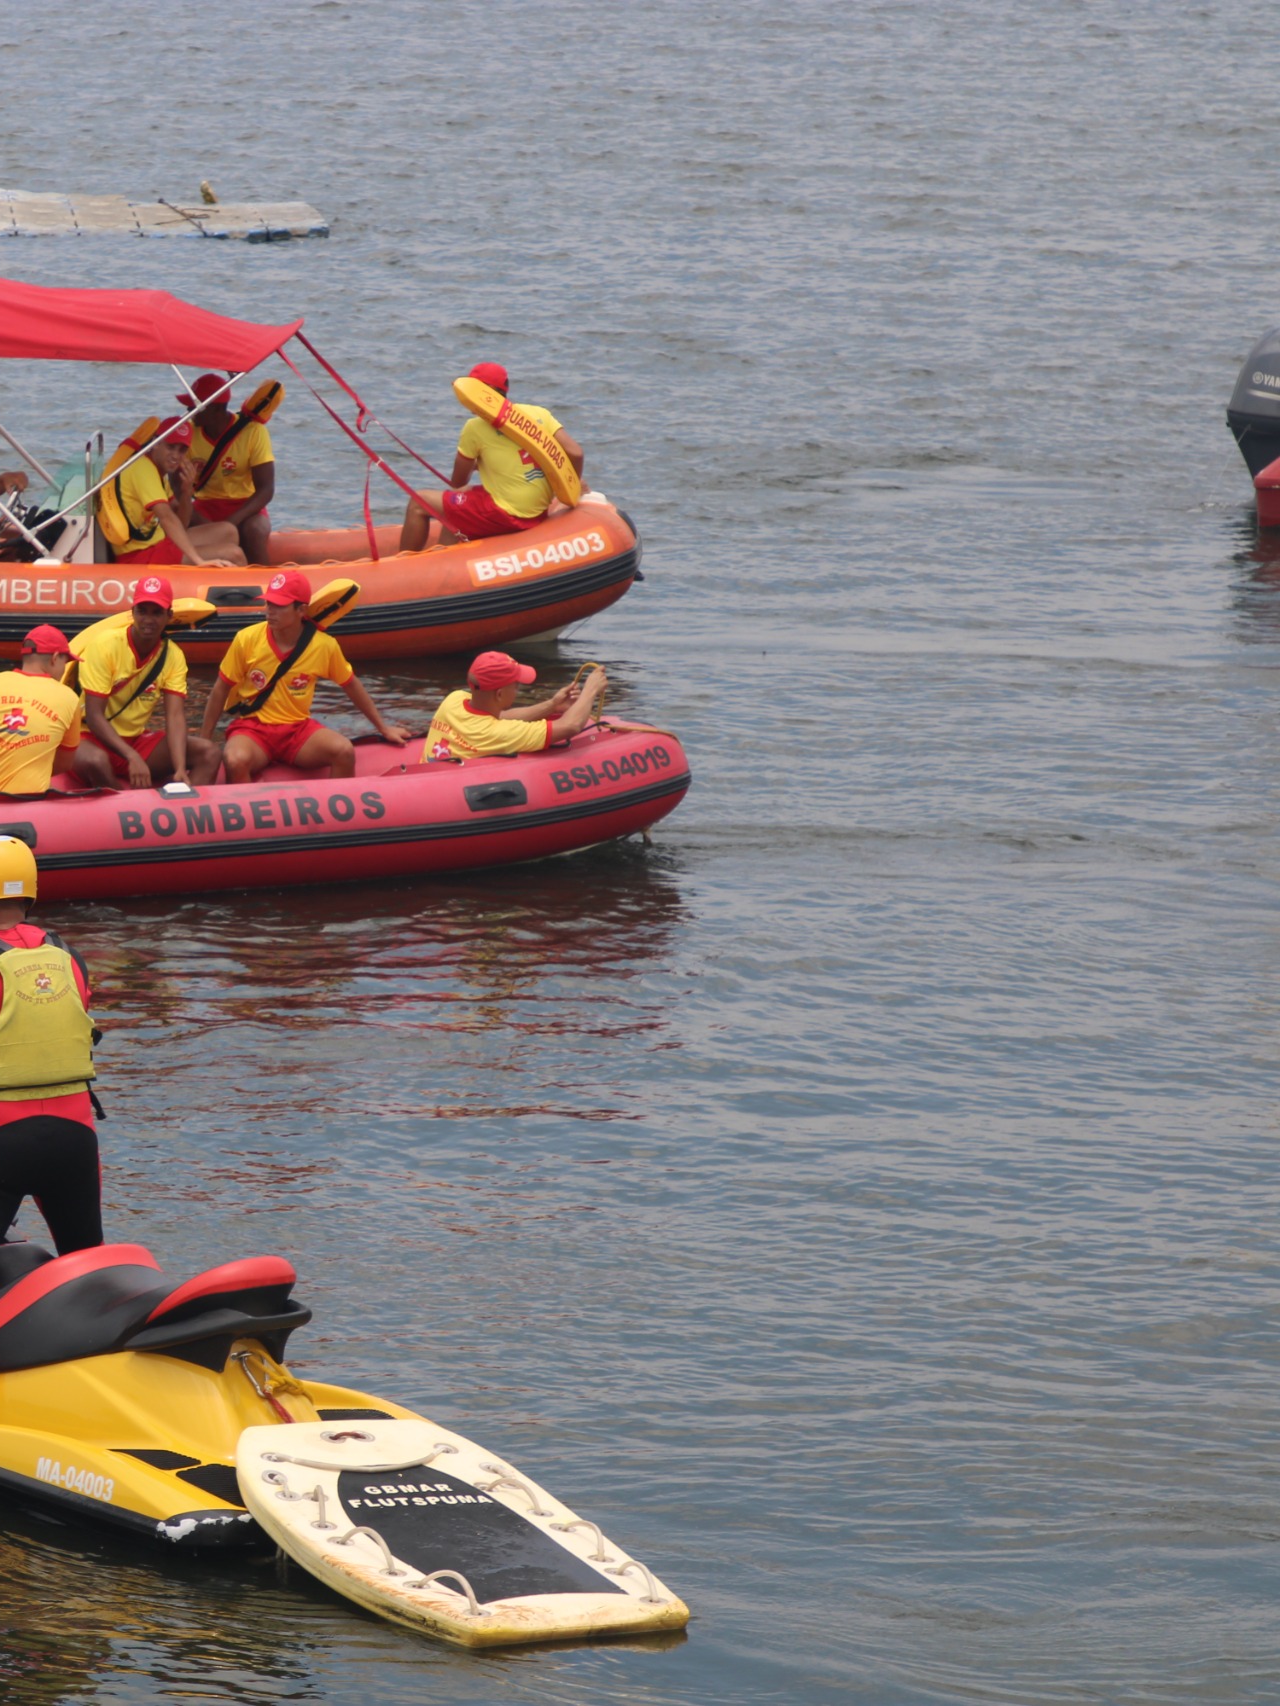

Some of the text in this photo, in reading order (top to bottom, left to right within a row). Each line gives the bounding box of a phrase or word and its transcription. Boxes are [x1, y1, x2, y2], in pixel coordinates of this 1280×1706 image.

[473, 532, 606, 581] BSI-04003
[549, 745, 672, 794] BSI-04019
[117, 791, 386, 840] BOMBEIROS
[36, 1456, 115, 1502] MA-04003
[348, 1494, 494, 1509] FLUTSPUMA
[364, 1483, 453, 1495] GBMAR
